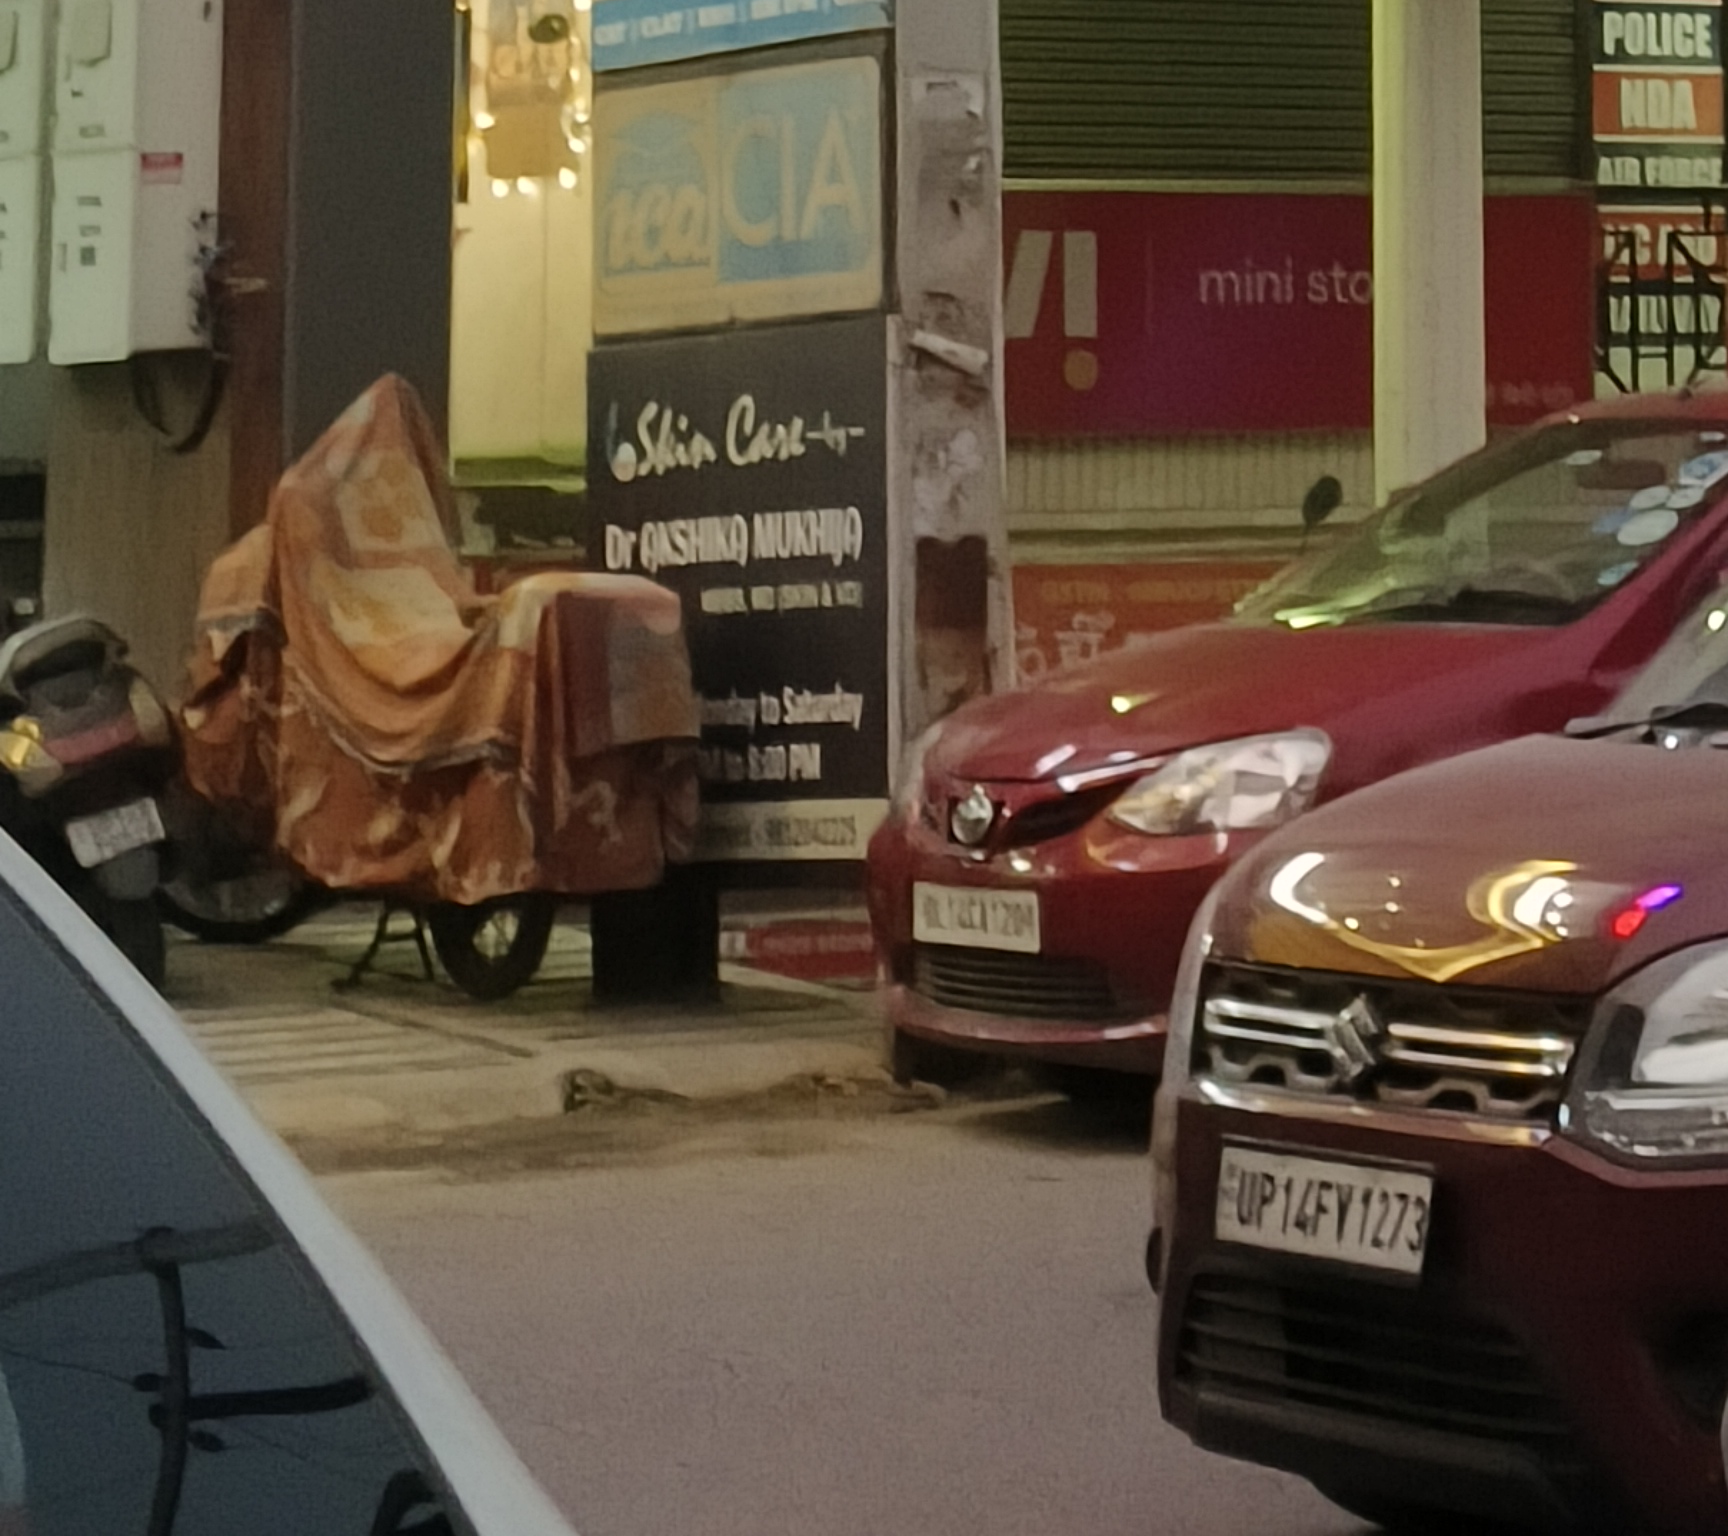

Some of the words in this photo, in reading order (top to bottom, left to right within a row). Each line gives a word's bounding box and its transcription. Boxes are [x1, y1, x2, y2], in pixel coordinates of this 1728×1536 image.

[1603, 11, 1712, 58] POLICE
[1200, 257, 1294, 306] mini
[1308, 261, 1375, 305] sto
[605, 523, 636, 571] Dr
